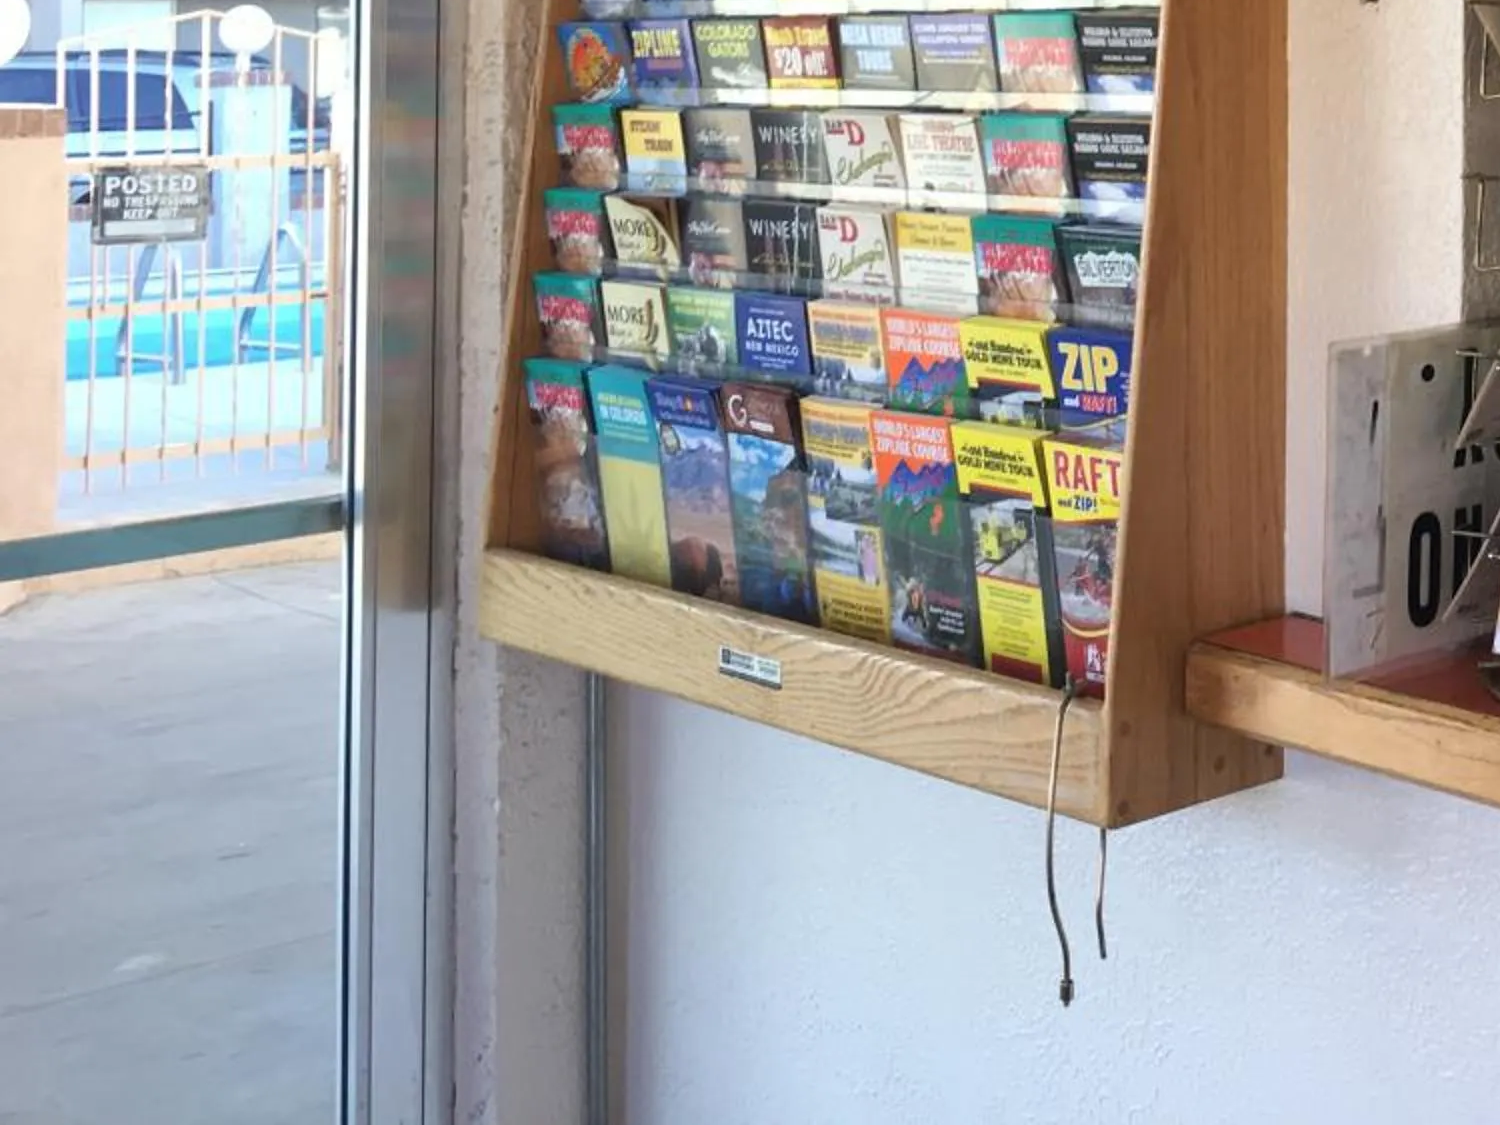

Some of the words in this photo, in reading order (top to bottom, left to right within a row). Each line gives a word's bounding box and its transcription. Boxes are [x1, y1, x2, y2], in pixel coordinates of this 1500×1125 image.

[775, 47, 803, 77] $20
[758, 125, 819, 146] WINERY
[844, 119, 865, 146] D
[105, 174, 197, 195] POSTED
[103, 196, 119, 208] NO
[124, 193, 199, 208] TRESPASSING
[123, 208, 152, 220] KEEP
[156, 207, 178, 220] OUT
[749, 218, 810, 240] WINERY
[838, 216, 859, 244] D
[606, 305, 645, 326] MORE
[746, 317, 794, 342] AZTEC
[744, 339, 763, 353] NEW
[765, 341, 800, 359] MEXICO
[1057, 341, 1120, 394] ZIP
[1053, 450, 1122, 499] RAFT
[1074, 494, 1098, 513] ZIP!
